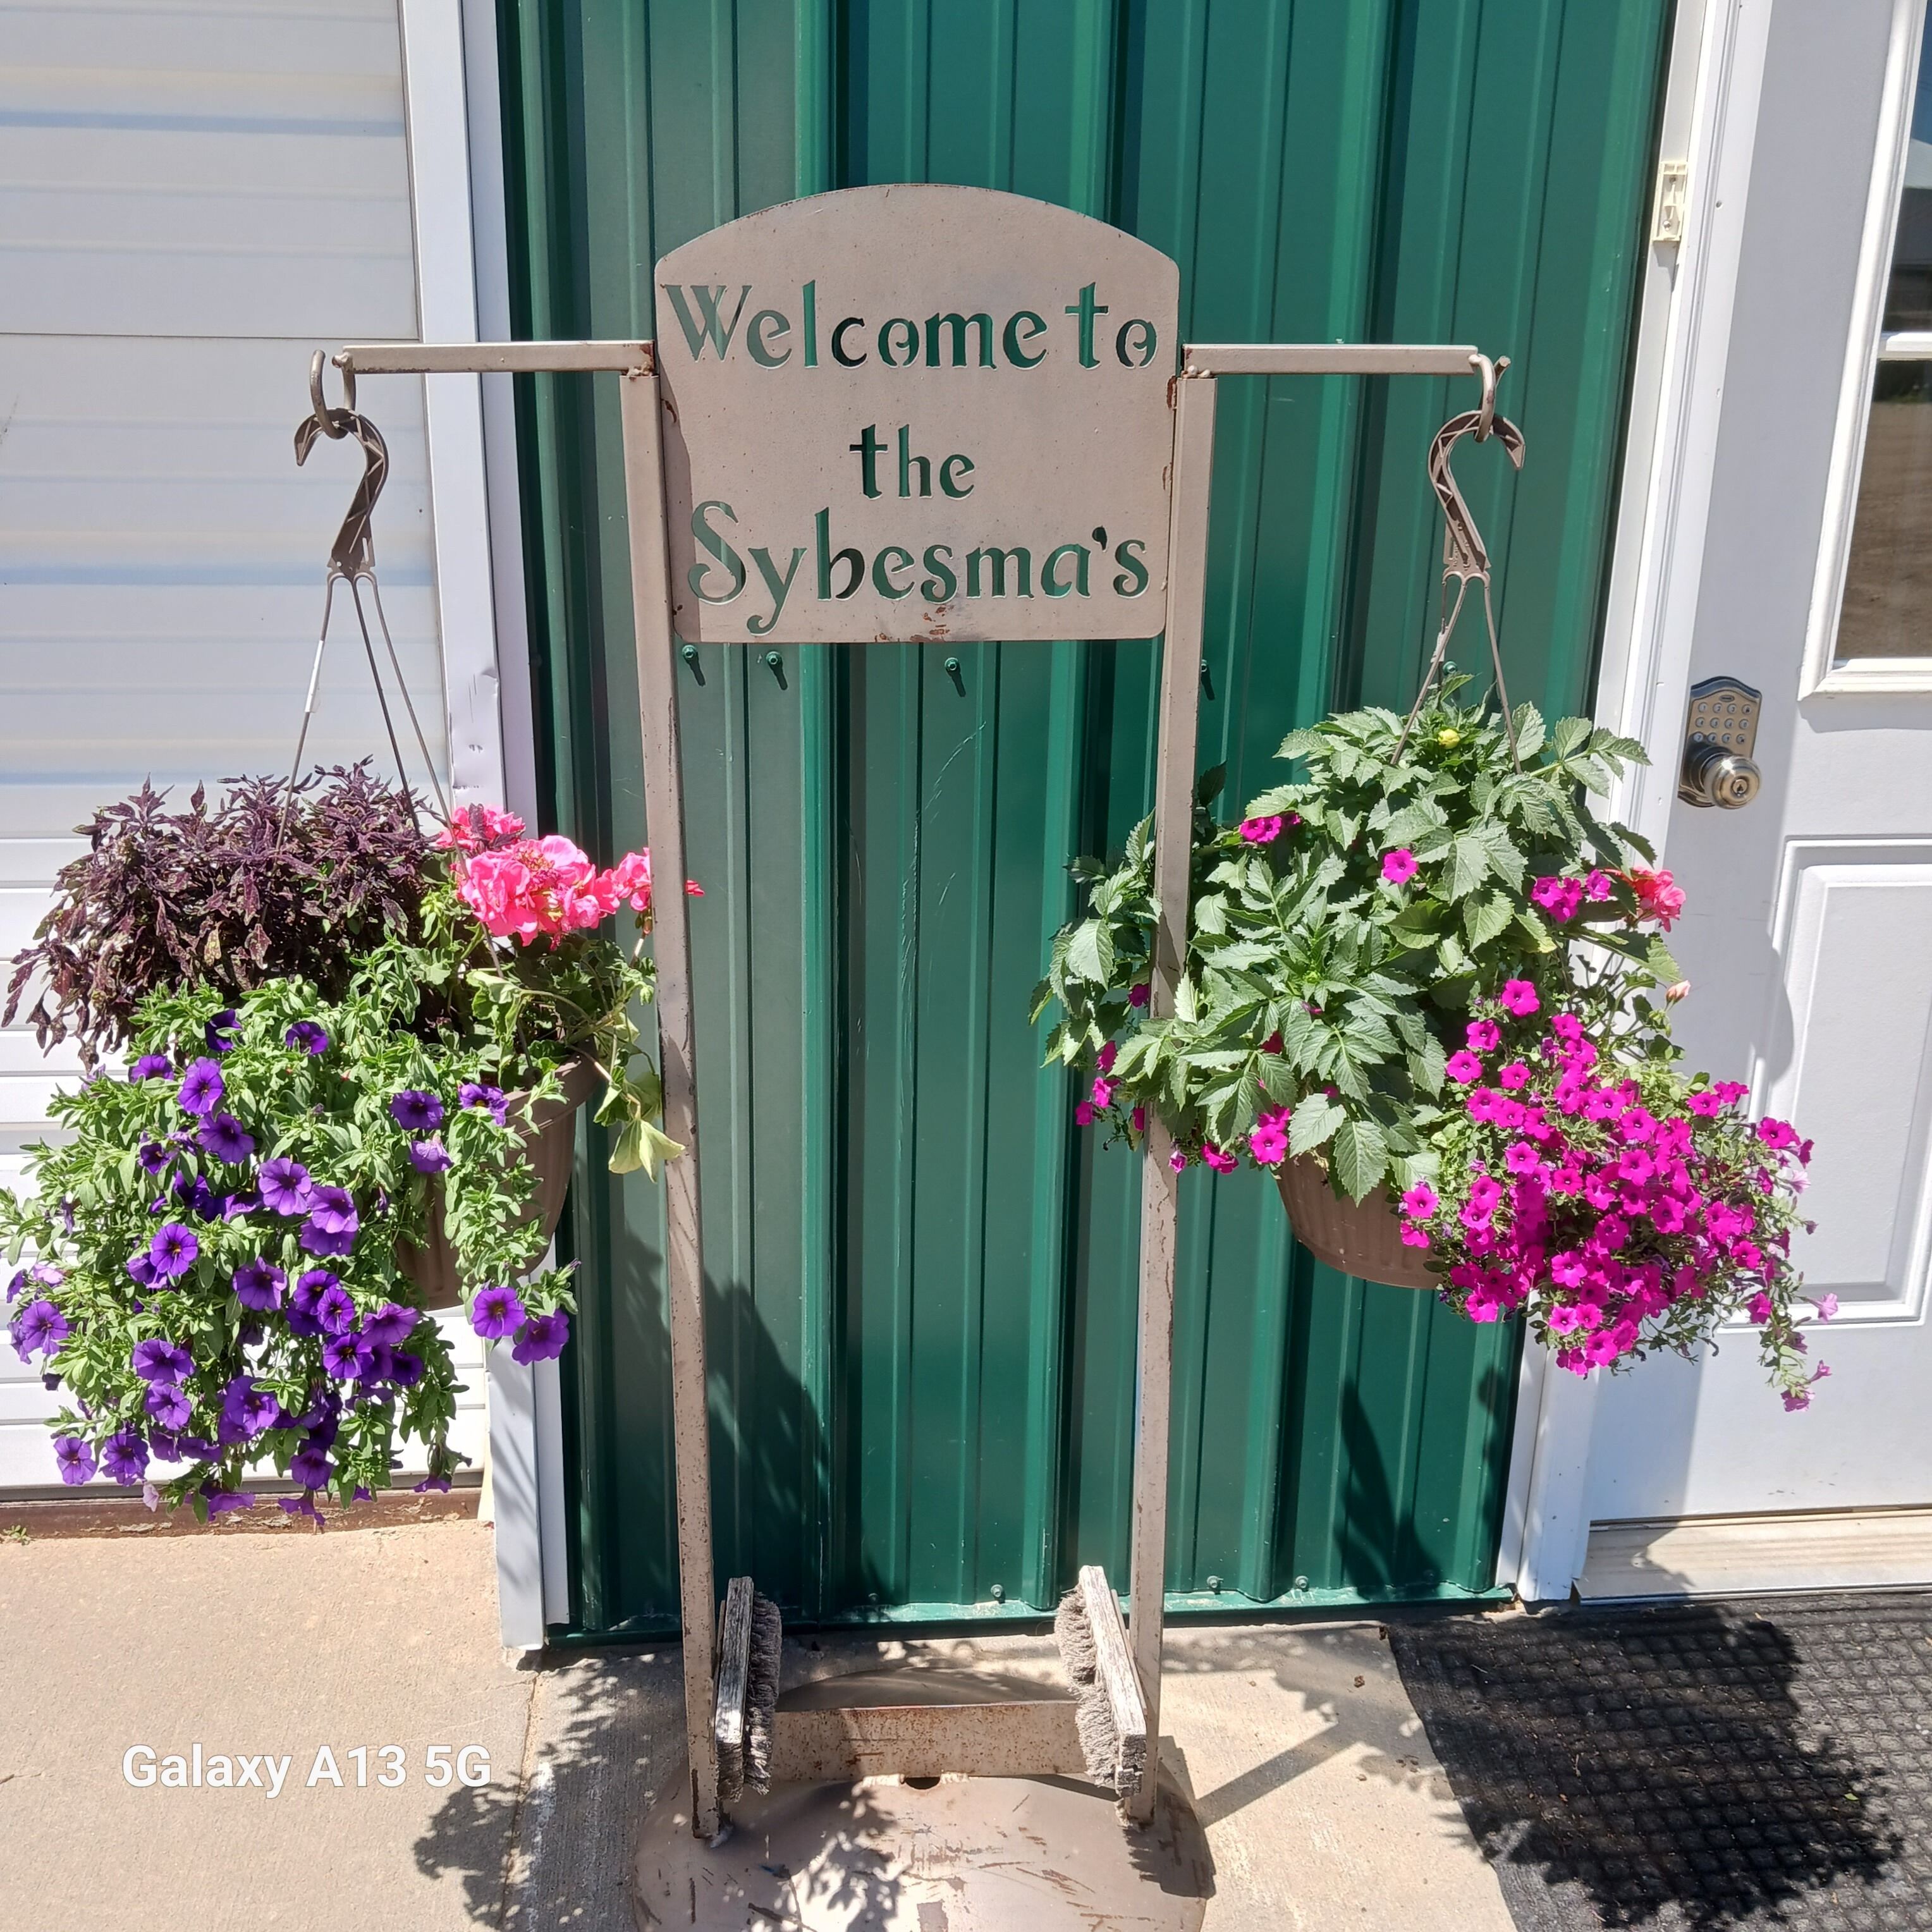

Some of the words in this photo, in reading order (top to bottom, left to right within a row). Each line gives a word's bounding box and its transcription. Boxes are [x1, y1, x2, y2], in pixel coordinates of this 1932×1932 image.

[663, 279, 1048, 370] Welcome
[1064, 281, 1158, 369] to
[849, 423, 976, 499] the
[687, 501, 1151, 637] Sybesma's
